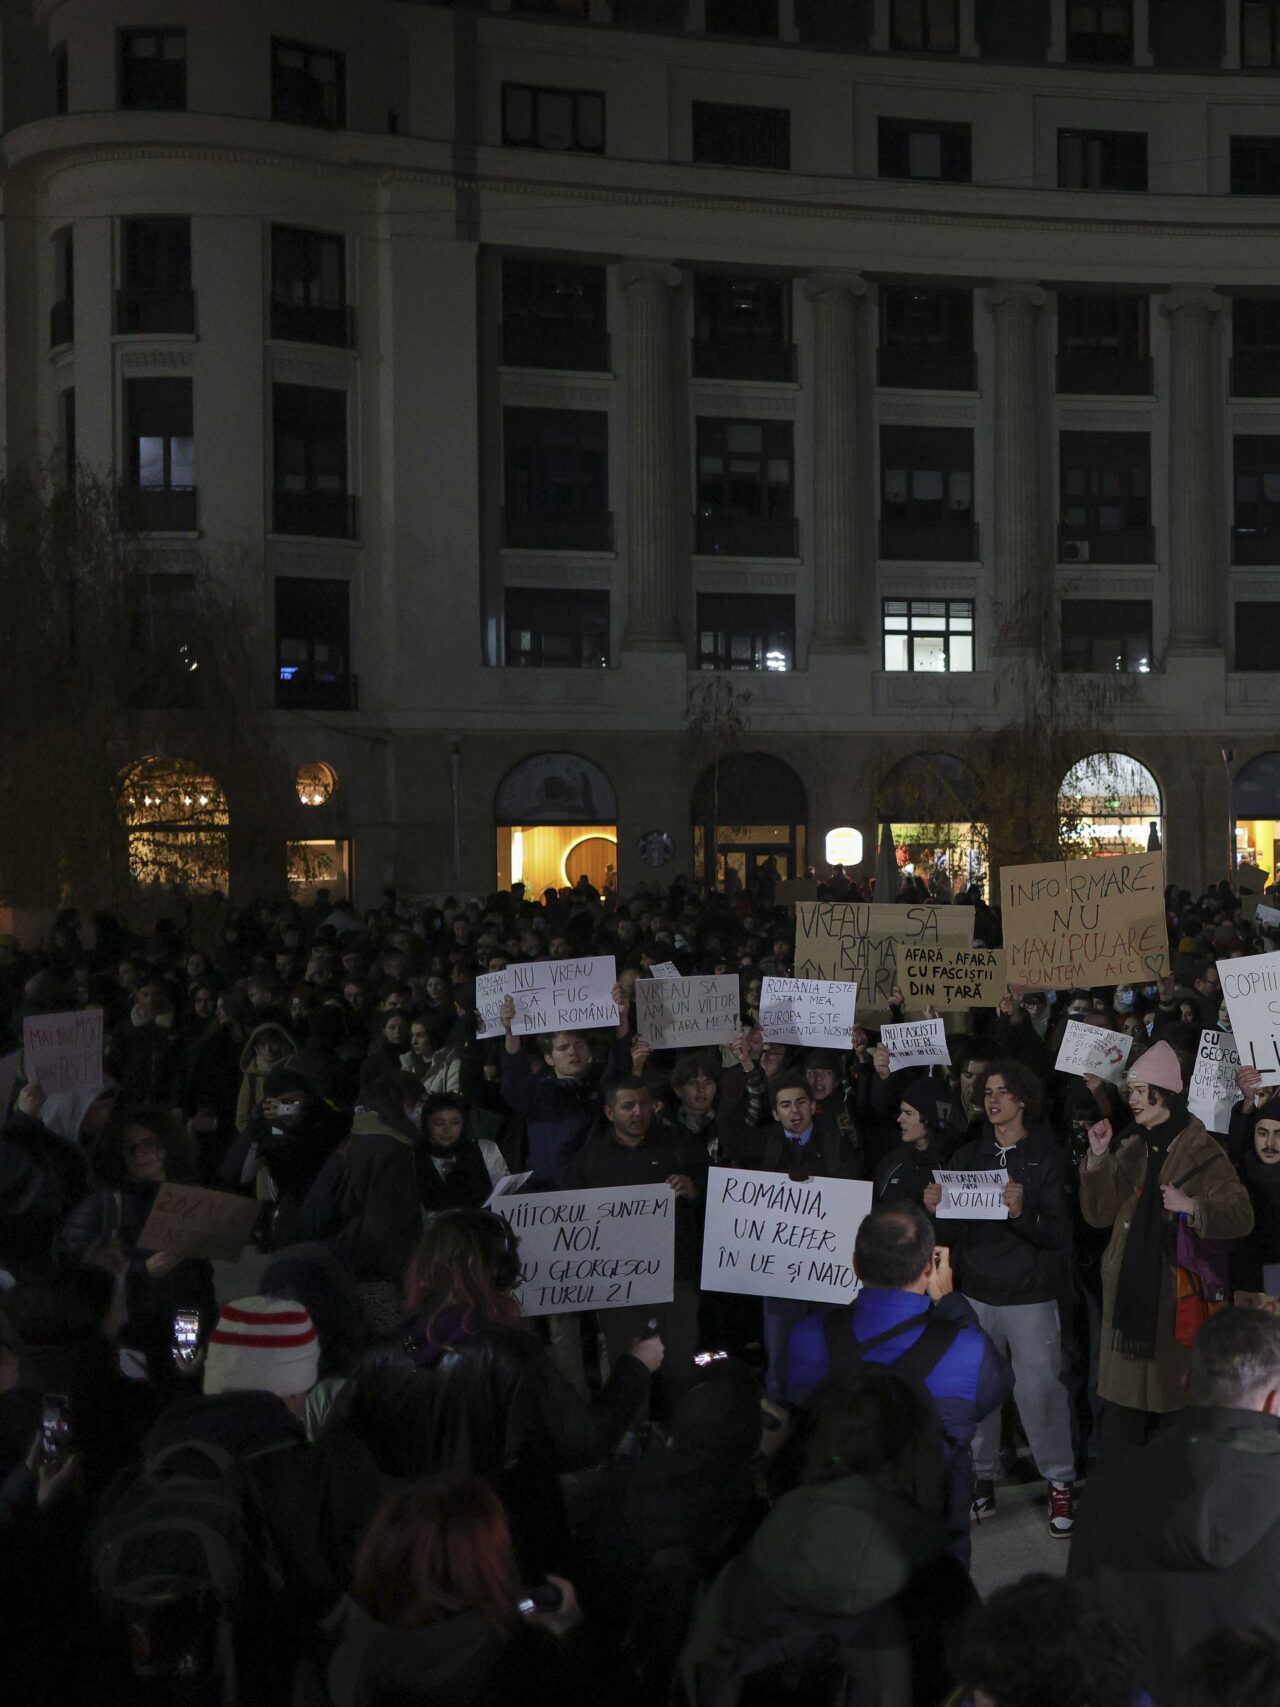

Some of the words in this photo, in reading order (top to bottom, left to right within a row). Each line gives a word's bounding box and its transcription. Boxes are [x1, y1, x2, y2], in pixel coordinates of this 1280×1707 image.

[800, 904, 870, 938] VREAU
[907, 906, 943, 944] SĂ
[1052, 904, 1100, 932] NU
[838, 935, 900, 970] RĂMÂ
[956, 951, 996, 967] AFARĂ
[514, 966, 535, 989] NU
[549, 963, 593, 985] VREAU
[907, 965, 927, 978] CU
[1019, 962, 1086, 985] SUNTEM
[1104, 956, 1144, 977] AICI
[1225, 965, 1277, 998] COPIII
[553, 986, 590, 1006] FUG
[640, 980, 691, 1003] VREAU
[770, 994, 803, 1004] PATRIA
[828, 983, 855, 994] ESTE
[909, 981, 935, 996] DIN
[944, 985, 982, 1003] ȚARĂ
[524, 1011, 546, 1031] DIN
[559, 1003, 619, 1024] ROMÂNIA
[644, 1003, 663, 1020] AM
[672, 1000, 690, 1016] UN
[699, 993, 736, 1015] VIITOR
[763, 1011, 802, 1026] EUROPA
[809, 1011, 840, 1024] ESTE
[1204, 1032, 1219, 1045] CU
[598, 1199, 668, 1221] SUNTEM
[722, 1178, 827, 1220] ROMÂNIA,
[734, 1218, 765, 1241] UN
[772, 1222, 837, 1253] REPER
[550, 1259, 660, 1282] GEORGESCU
[718, 1246, 740, 1268] ÎN
[751, 1253, 776, 1275] UE
[808, 1261, 860, 1293] NATO!
[540, 1286, 597, 1306] TURUL
